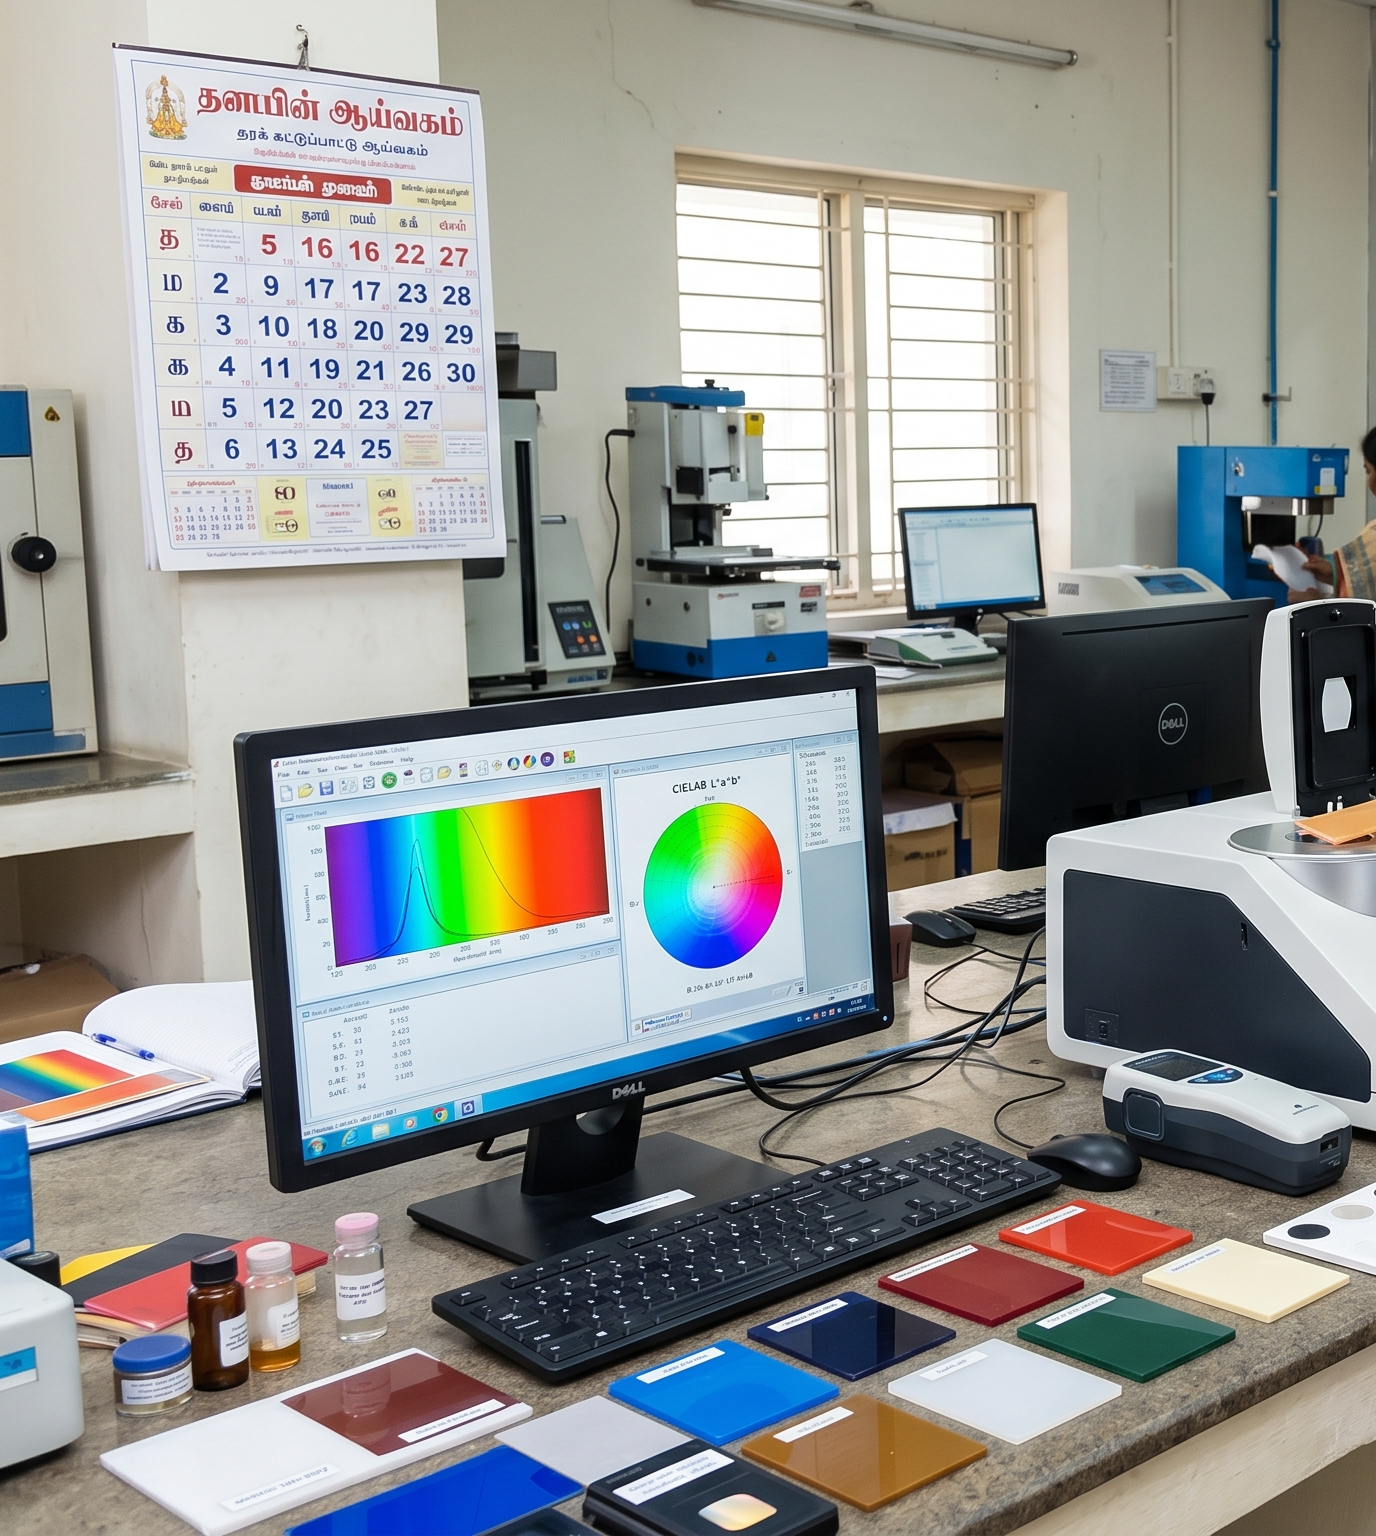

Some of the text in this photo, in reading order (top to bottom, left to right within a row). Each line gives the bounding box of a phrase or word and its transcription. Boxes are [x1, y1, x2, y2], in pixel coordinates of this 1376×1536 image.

[329, 98, 463, 137] ஆய்வகம்
[236, 127, 429, 157] தரக் கட்டுப்பாட்டு ஆய்வகம்
[262, 234, 276, 255] 5
[302, 237, 332, 258] 16
[349, 240, 379, 262] 16
[395, 244, 425, 264] 22
[440, 247, 468, 267] 27
[163, 274, 182, 291] ம
[214, 273, 228, 294] 2
[264, 275, 278, 296] 9
[305, 278, 334, 298] 17
[353, 281, 380, 301] 17
[398, 283, 427, 303] 23
[443, 286, 471, 306] 28
[216, 315, 231, 335] 3
[259, 316, 289, 337] 10
[308, 318, 337, 339] 18
[354, 320, 383, 341] 20
[400, 322, 428, 342] 29
[445, 325, 473, 344] 29
[219, 356, 235, 376] 4
[261, 357, 289, 378] 11
[310, 359, 339, 379] 19
[357, 360, 383, 380] 21
[402, 362, 431, 381] 26
[447, 363, 475, 382] 30
[223, 398, 236, 418] 5
[264, 398, 294, 418] 12
[312, 399, 342, 419] 20
[359, 400, 389, 419] 23
[404, 401, 433, 420] 27
[175, 442, 193, 464] த
[225, 439, 239, 459] 6
[267, 439, 297, 459] 13
[314, 439, 345, 459] 24
[362, 439, 391, 459] 25
[672, 780, 707, 794] CIELAB
[612, 1081, 646, 1100] DELL
